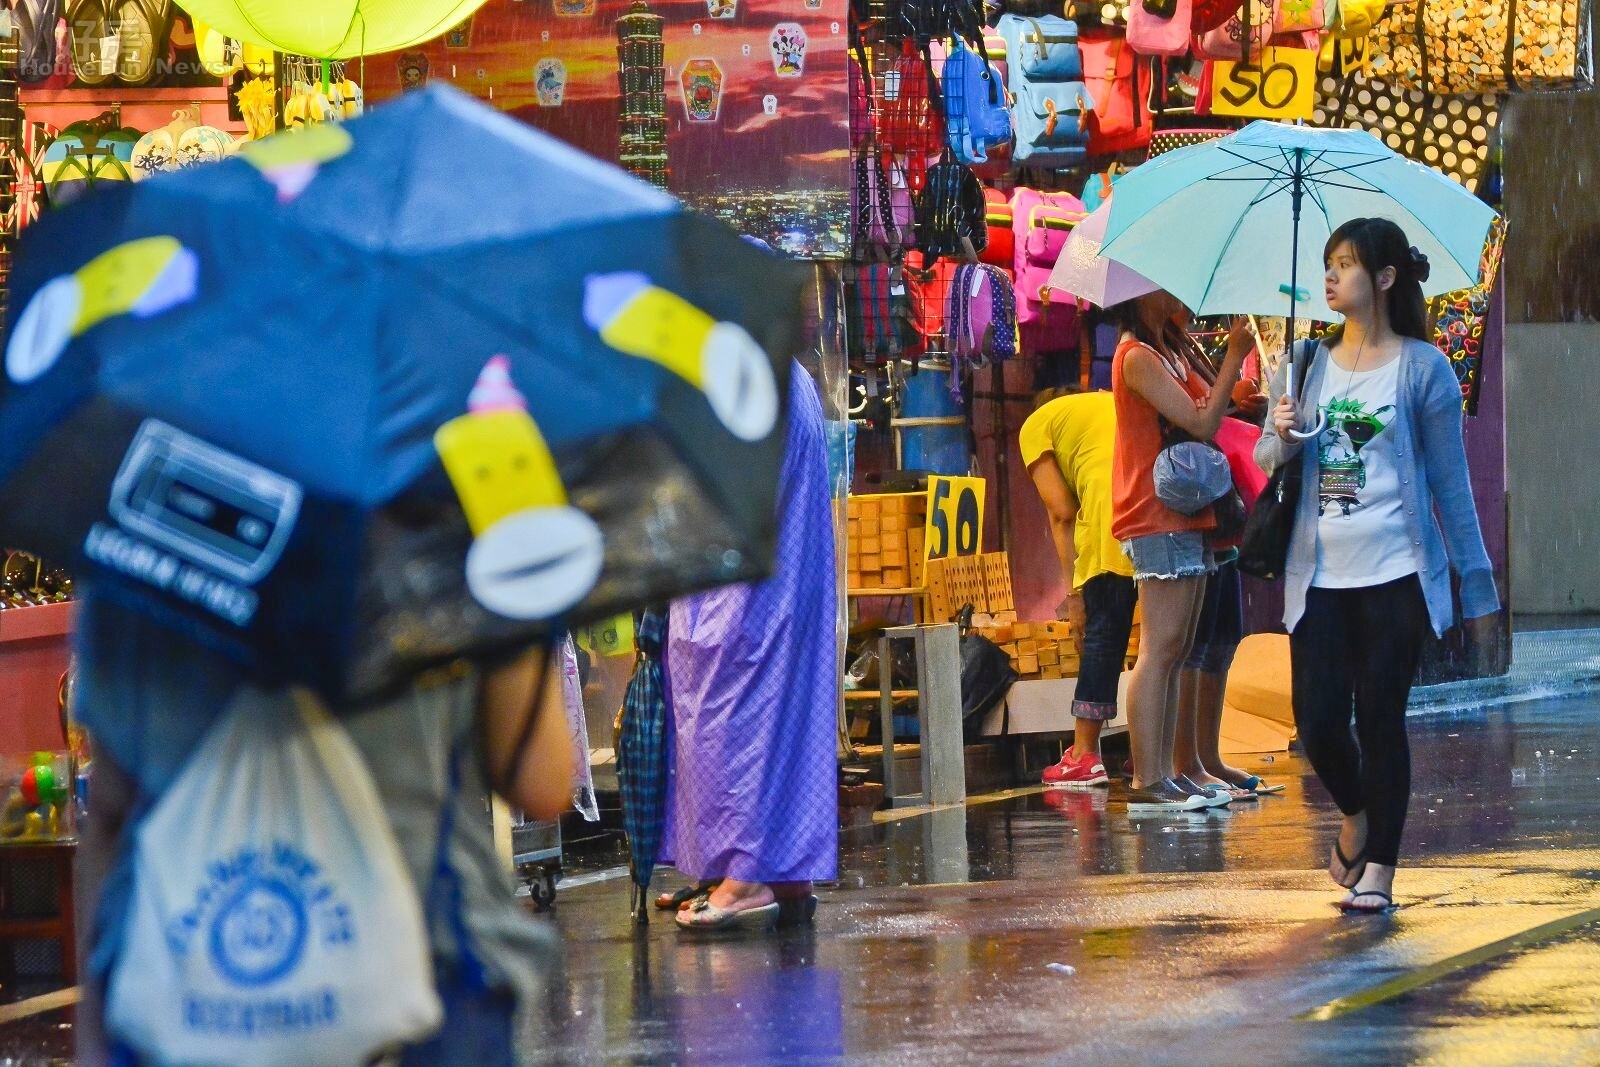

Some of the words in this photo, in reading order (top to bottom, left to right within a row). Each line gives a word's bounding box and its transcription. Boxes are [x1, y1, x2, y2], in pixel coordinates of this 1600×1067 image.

[1220, 61, 1298, 109] 50
[1329, 403, 1360, 414] KING
[928, 478, 979, 558] 50
